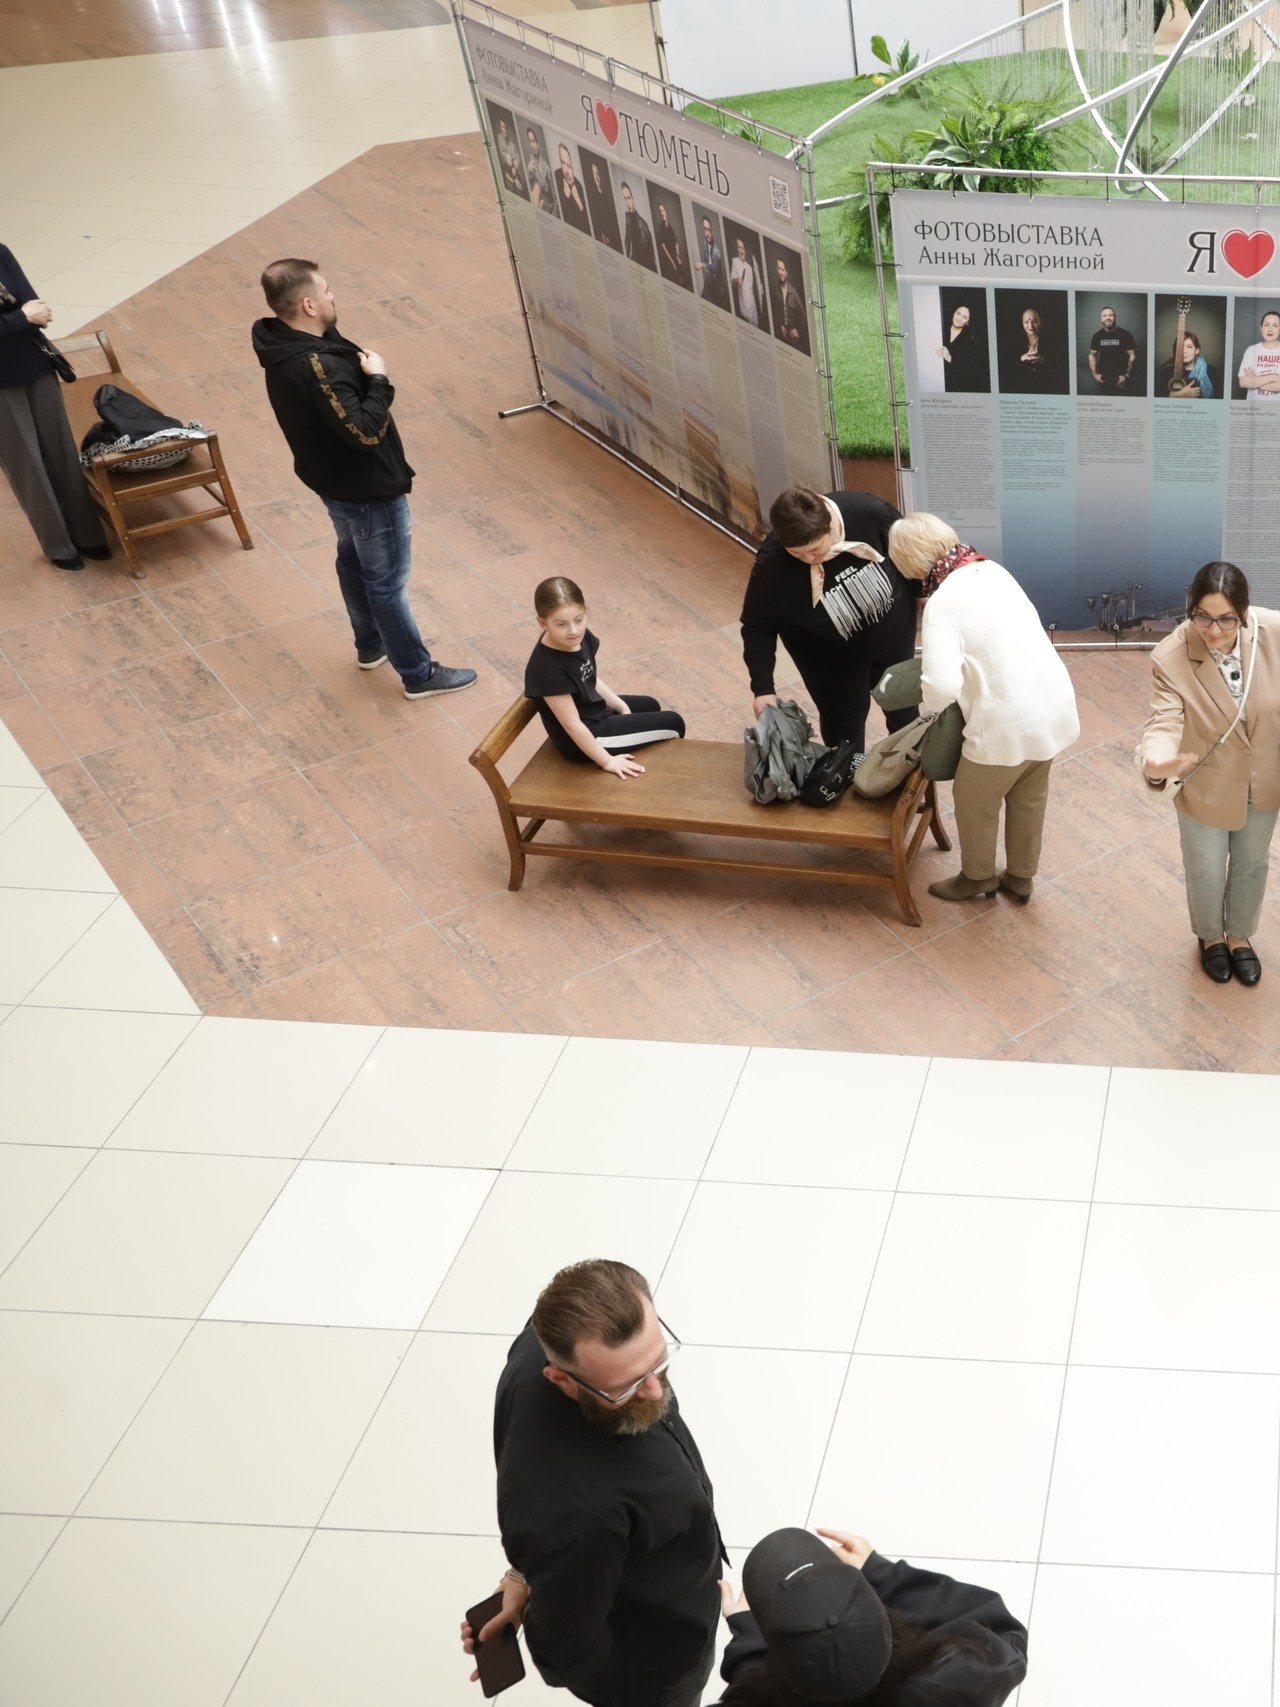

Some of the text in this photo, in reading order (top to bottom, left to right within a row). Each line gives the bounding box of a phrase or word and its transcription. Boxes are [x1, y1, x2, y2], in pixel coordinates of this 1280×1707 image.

[476, 44, 549, 94] ФОТОВЫСТАВКА
[581, 94, 730, 197] Я ТЮМЕНЬ
[914, 220, 1104, 246] ФОТОВЫСТАВКА
[919, 245, 1105, 273] Анны Жагориной
[1186, 231, 1217, 273] Я
[835, 566, 857, 582] FEEL
